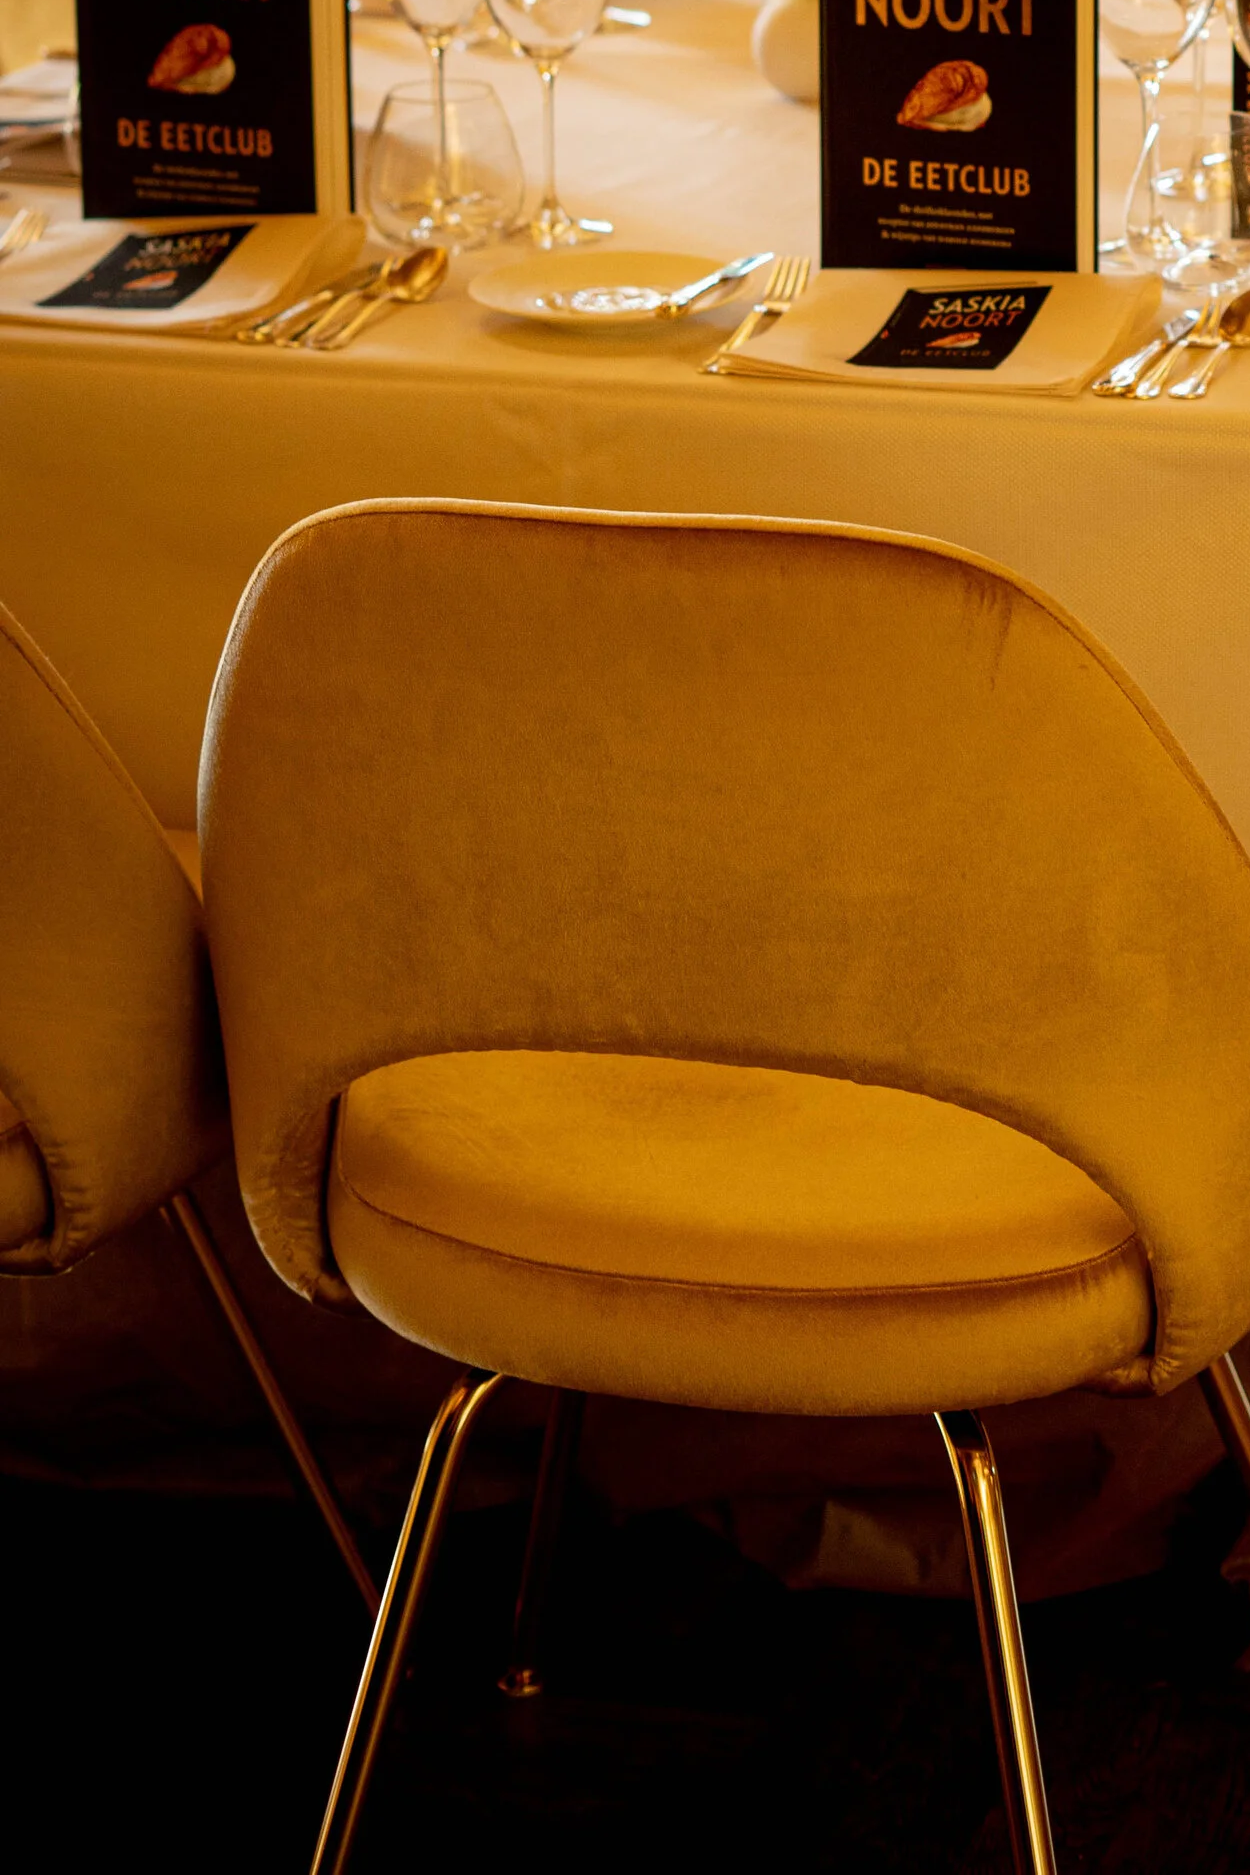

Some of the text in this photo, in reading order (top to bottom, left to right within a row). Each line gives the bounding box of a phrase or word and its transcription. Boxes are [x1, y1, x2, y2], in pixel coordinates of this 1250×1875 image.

[117, 118, 273, 158] DE EETCLUB
[863, 157, 1030, 197] DE EETCLUB
[928, 295, 1026, 314] SASKIA
[919, 310, 1022, 329] NOORT
